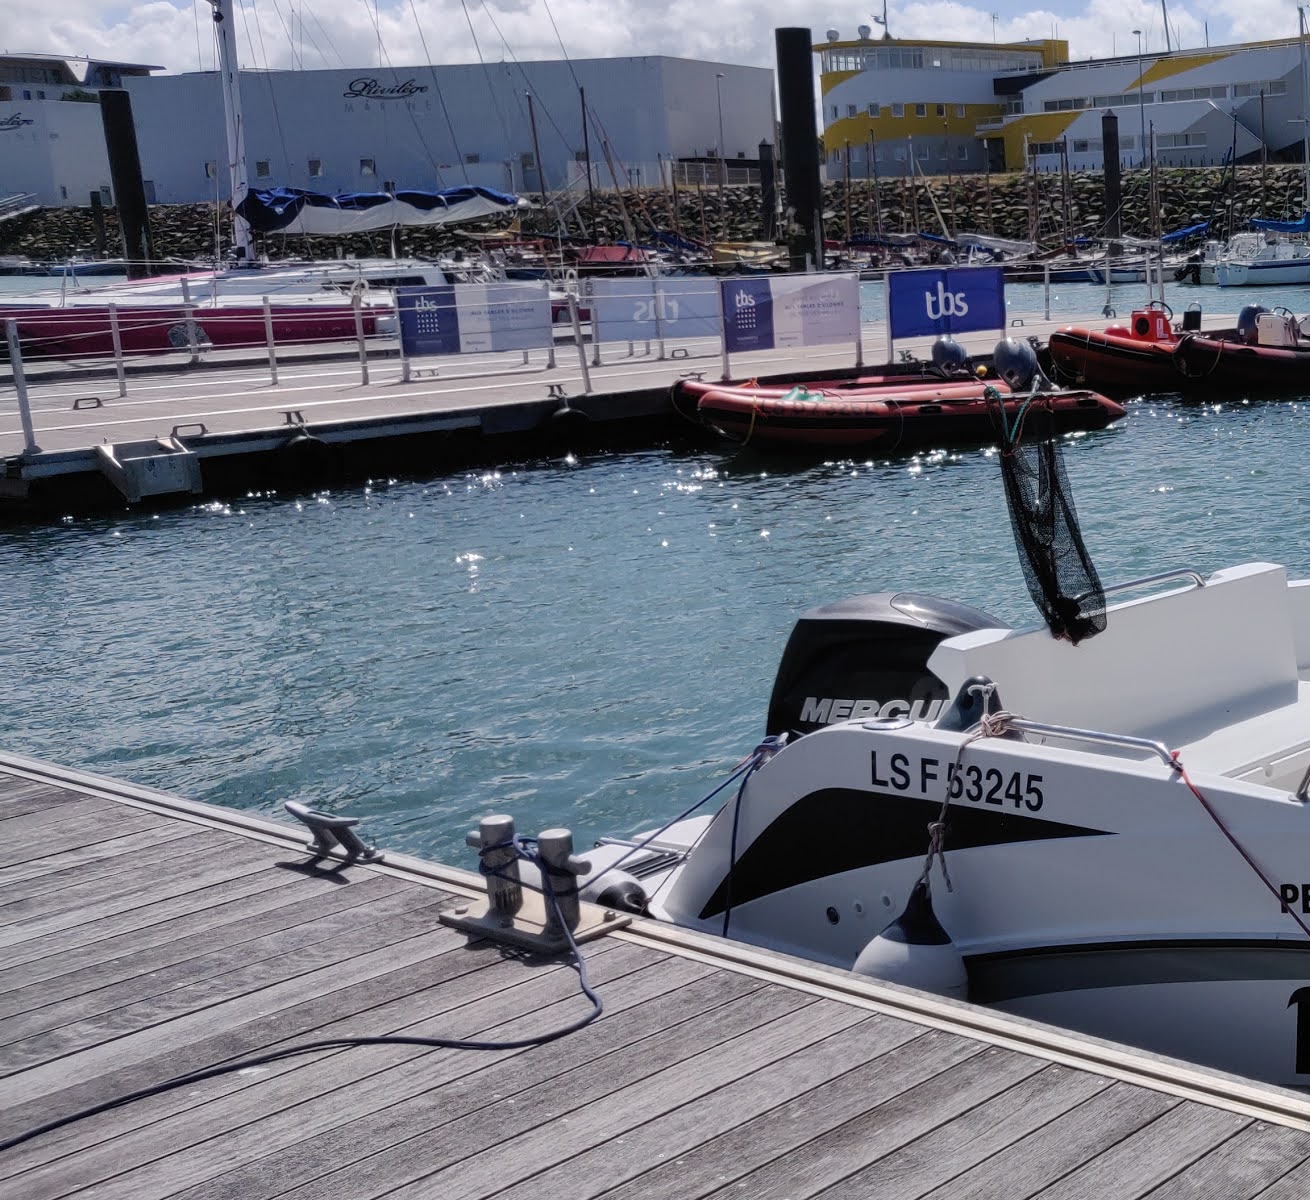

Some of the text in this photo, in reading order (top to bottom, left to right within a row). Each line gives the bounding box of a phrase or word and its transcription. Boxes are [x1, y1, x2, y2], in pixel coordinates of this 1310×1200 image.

[415, 296, 437, 313] tbs
[735, 289, 756, 307] tbs
[925, 281, 968, 319] tbs
[800, 697, 949, 724] MERCU
[871, 750, 1044, 812] LS F 53245
